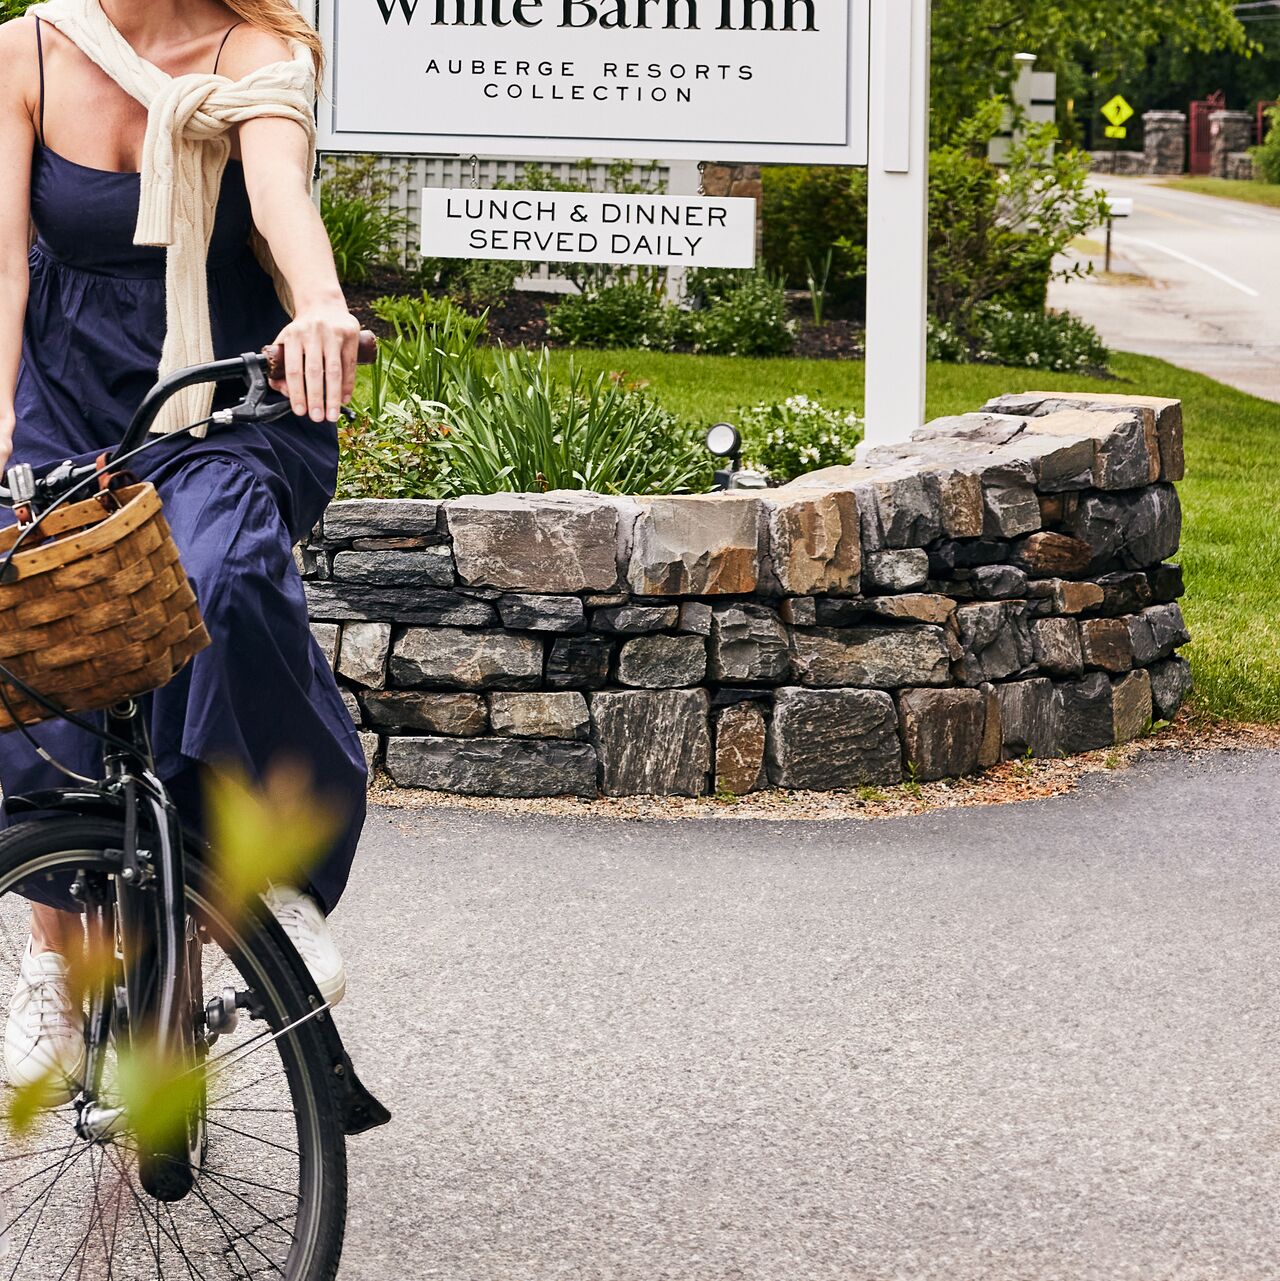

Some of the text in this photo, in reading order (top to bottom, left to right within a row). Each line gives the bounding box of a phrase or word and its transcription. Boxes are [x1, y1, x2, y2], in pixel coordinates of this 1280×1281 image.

[425, 59, 753, 81] AUBERGE RESORTS
[483, 83, 691, 103] COLLECTION
[446, 199, 728, 227] LUNCH & DINNER
[469, 229, 703, 257] SERVED DAILY
